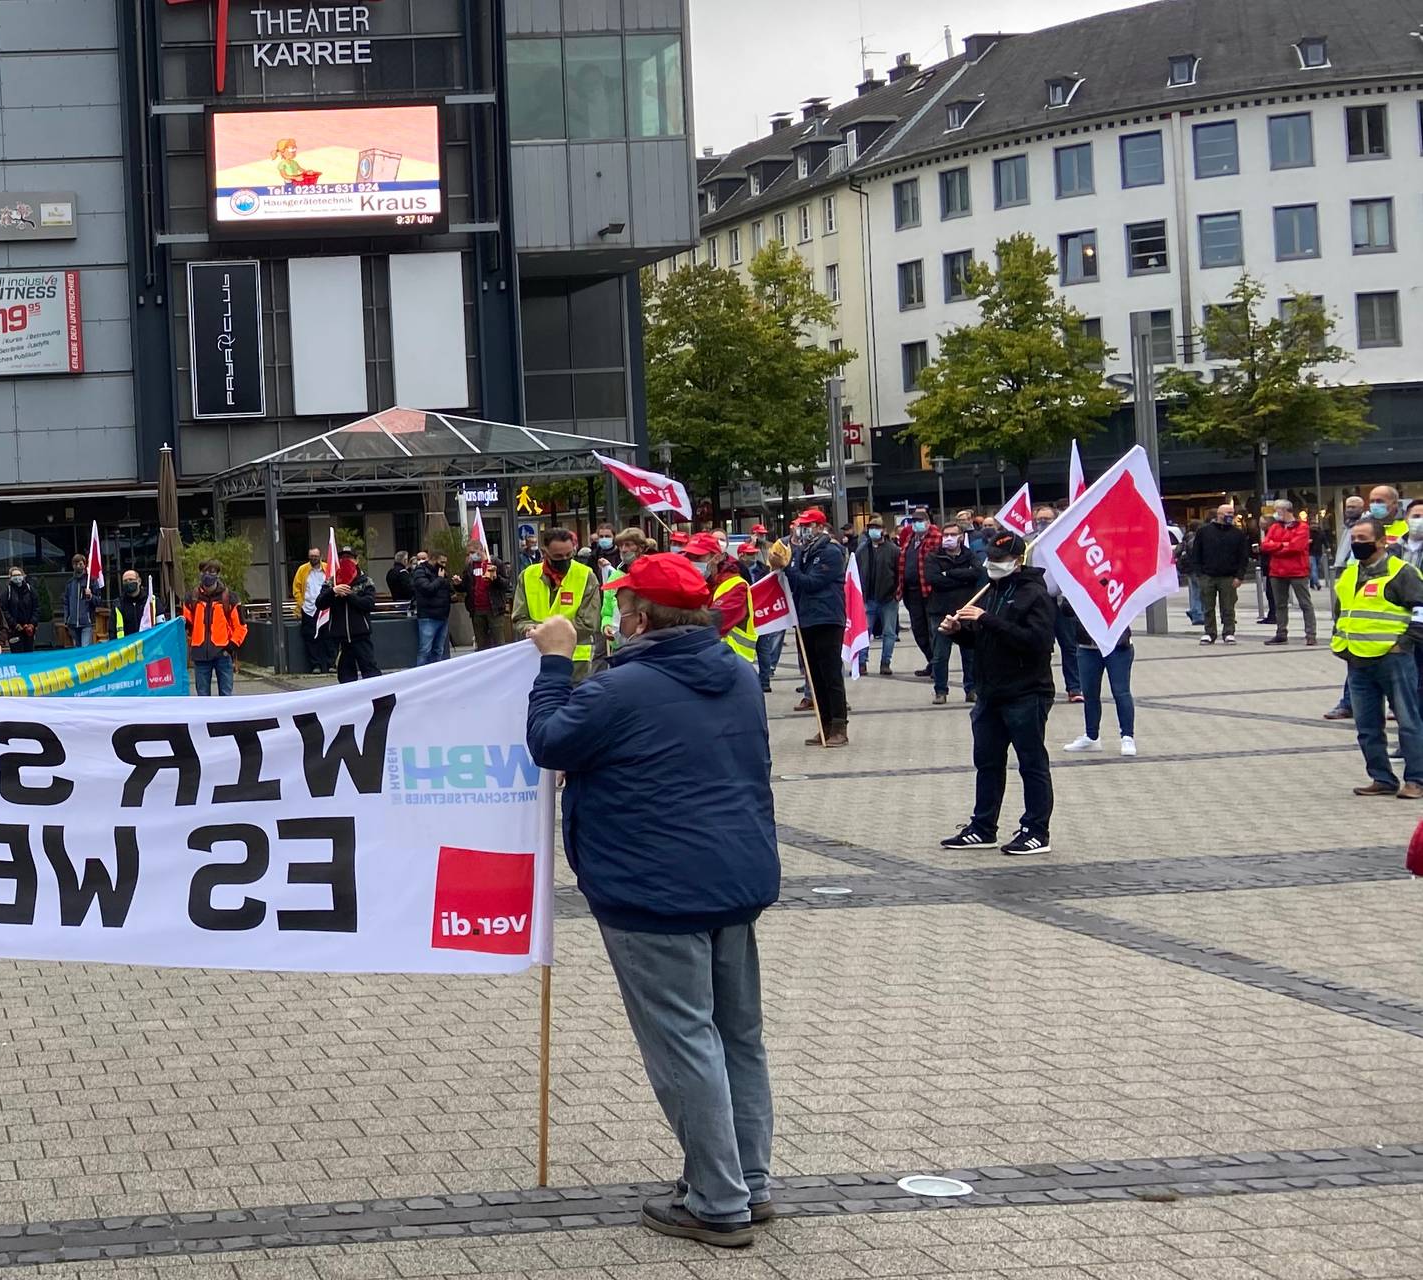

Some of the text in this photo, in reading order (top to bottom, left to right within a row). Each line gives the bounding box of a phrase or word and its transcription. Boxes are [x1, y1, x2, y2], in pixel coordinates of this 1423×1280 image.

[250, 6, 370, 35] THEATER
[253, 39, 373, 67] KARREE
[267, 182, 380, 195] Tel.: 02331-631 924
[360, 195, 427, 212] Kraus
[396, 214, 434, 225] 9:37 Uhr
[7, 274, 58, 286] inclusive
[67, 273, 79, 369] ERLEBE DEN UNTERSCHIED
[1077, 525, 1124, 612] ver.di
[29, 667, 75, 696] IHR
[75, 640, 145, 684] DRAN!
[148, 675, 172, 683] ver.di
